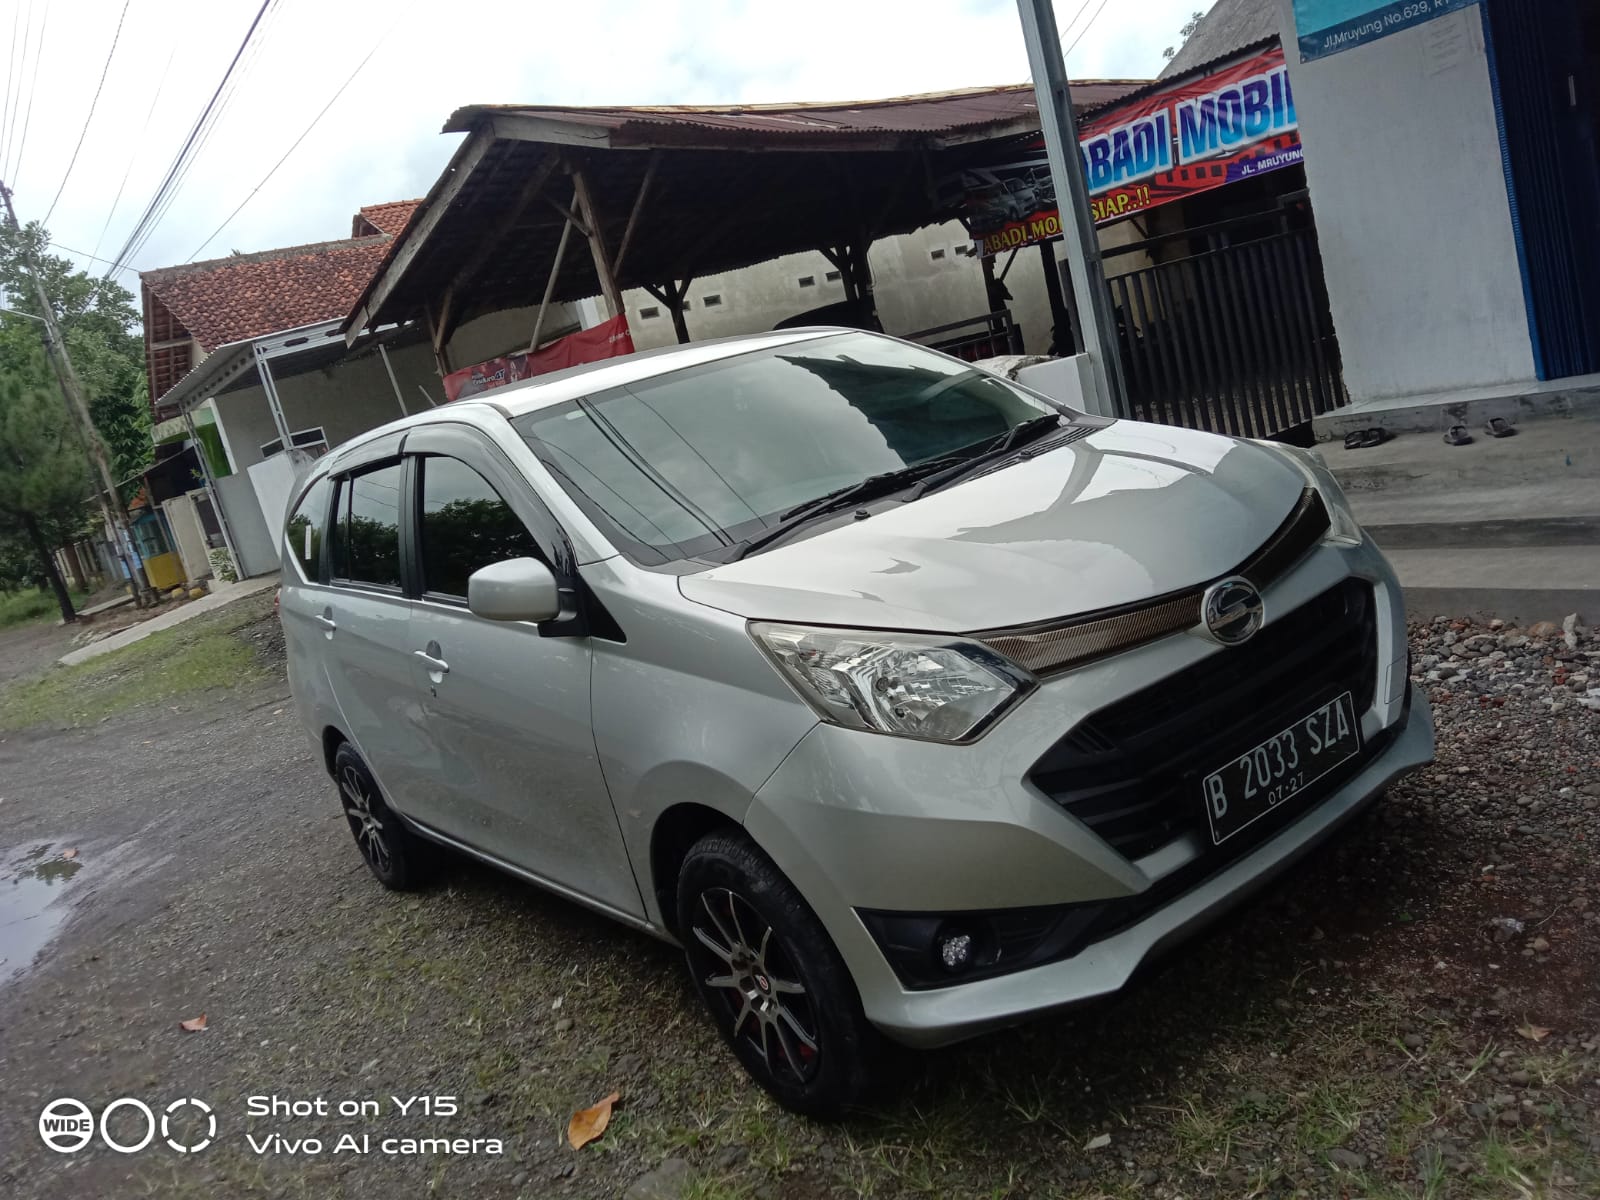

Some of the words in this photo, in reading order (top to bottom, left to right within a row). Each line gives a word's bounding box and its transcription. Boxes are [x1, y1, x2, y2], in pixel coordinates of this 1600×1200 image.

[1081, 115, 1169, 191] BADI
[1241, 163, 1256, 175] JL.
[983, 225, 1028, 253] ABADI
[1031, 216, 1063, 239] MO
[1208, 774, 1228, 819] B
[1239, 730, 1299, 799] 2033
[1305, 699, 1350, 755] SZA
